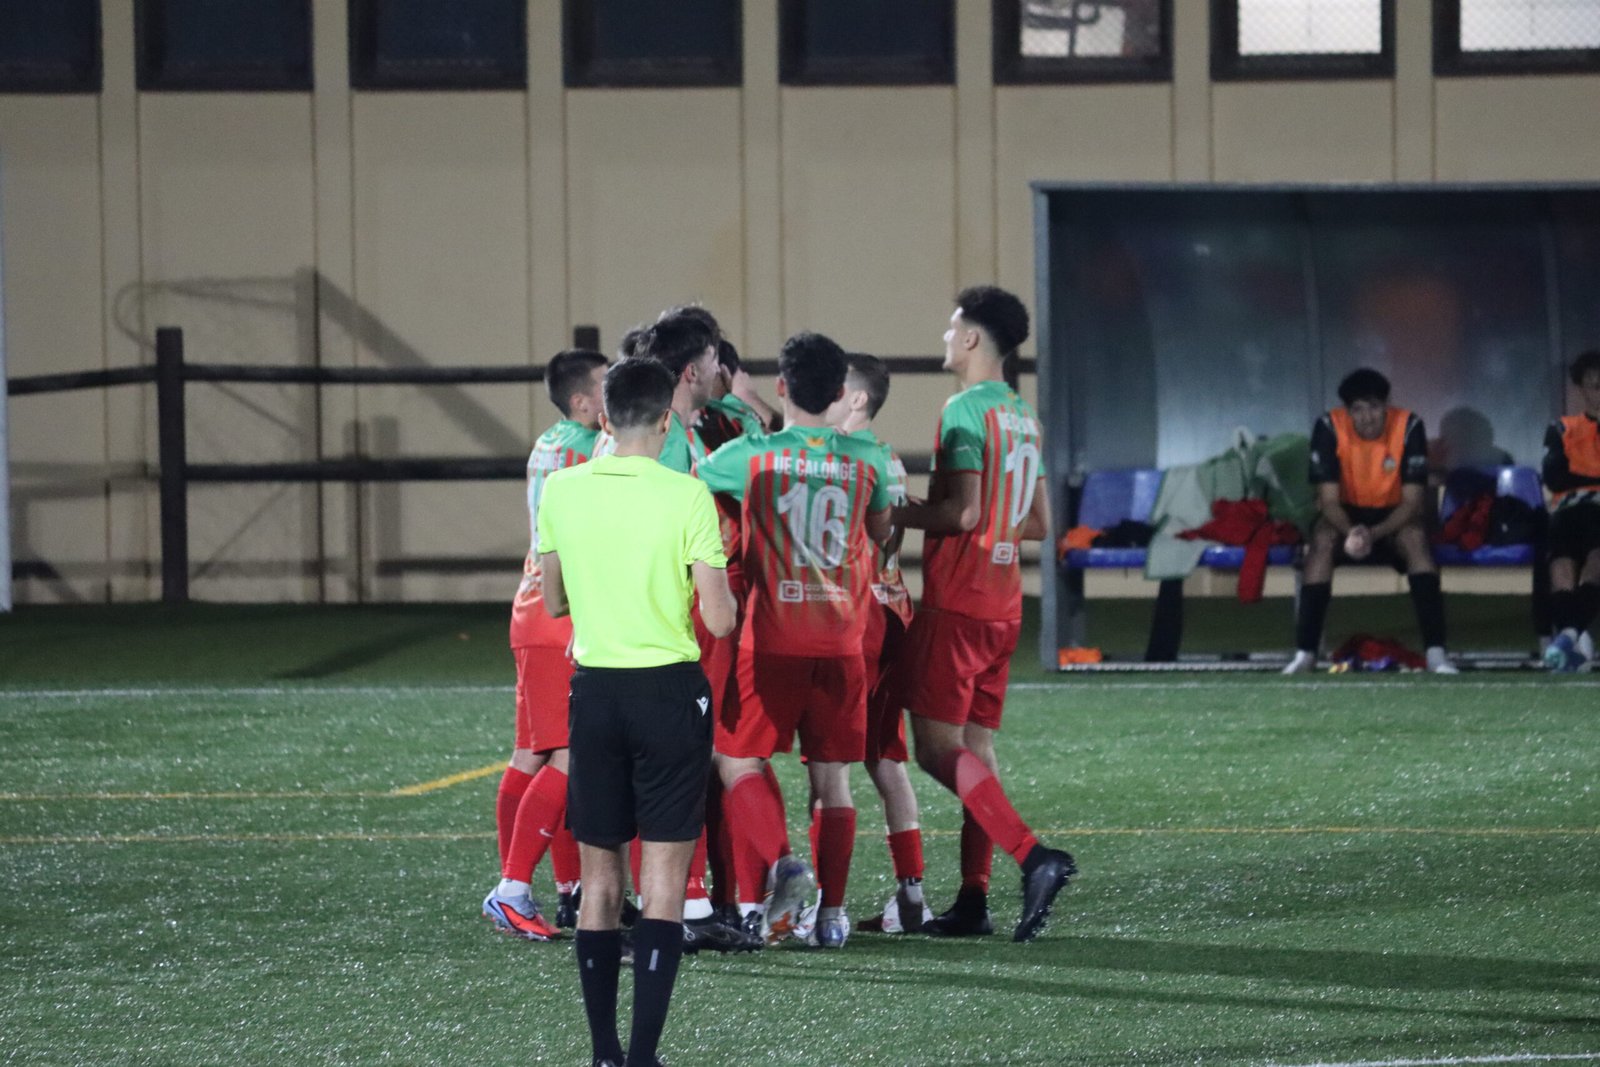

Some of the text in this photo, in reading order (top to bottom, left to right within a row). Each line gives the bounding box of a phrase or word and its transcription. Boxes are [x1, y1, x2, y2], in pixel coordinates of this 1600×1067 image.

[774, 456, 857, 481] UE CALONGE
[777, 482, 848, 569] 16
